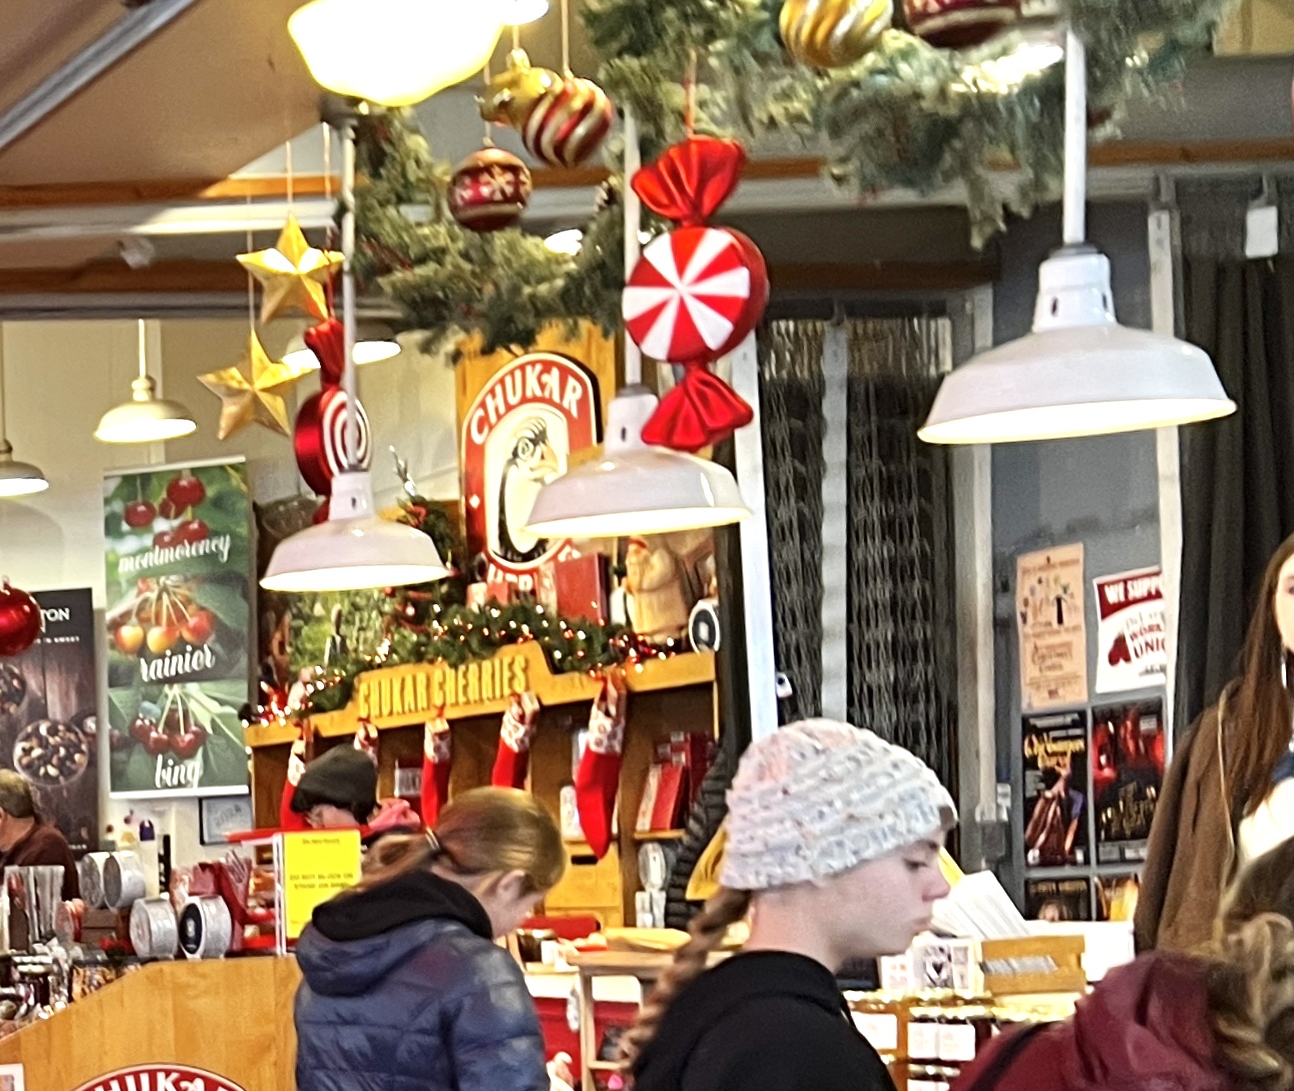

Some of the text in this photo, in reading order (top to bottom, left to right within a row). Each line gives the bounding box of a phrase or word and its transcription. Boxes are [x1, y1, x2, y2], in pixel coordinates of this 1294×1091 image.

[470, 363, 582, 445] CHUKAR
[140, 644, 216, 682] rainier
[359, 654, 526, 718] CHUKAR CHERRIES
[155, 753, 200, 789] bing
